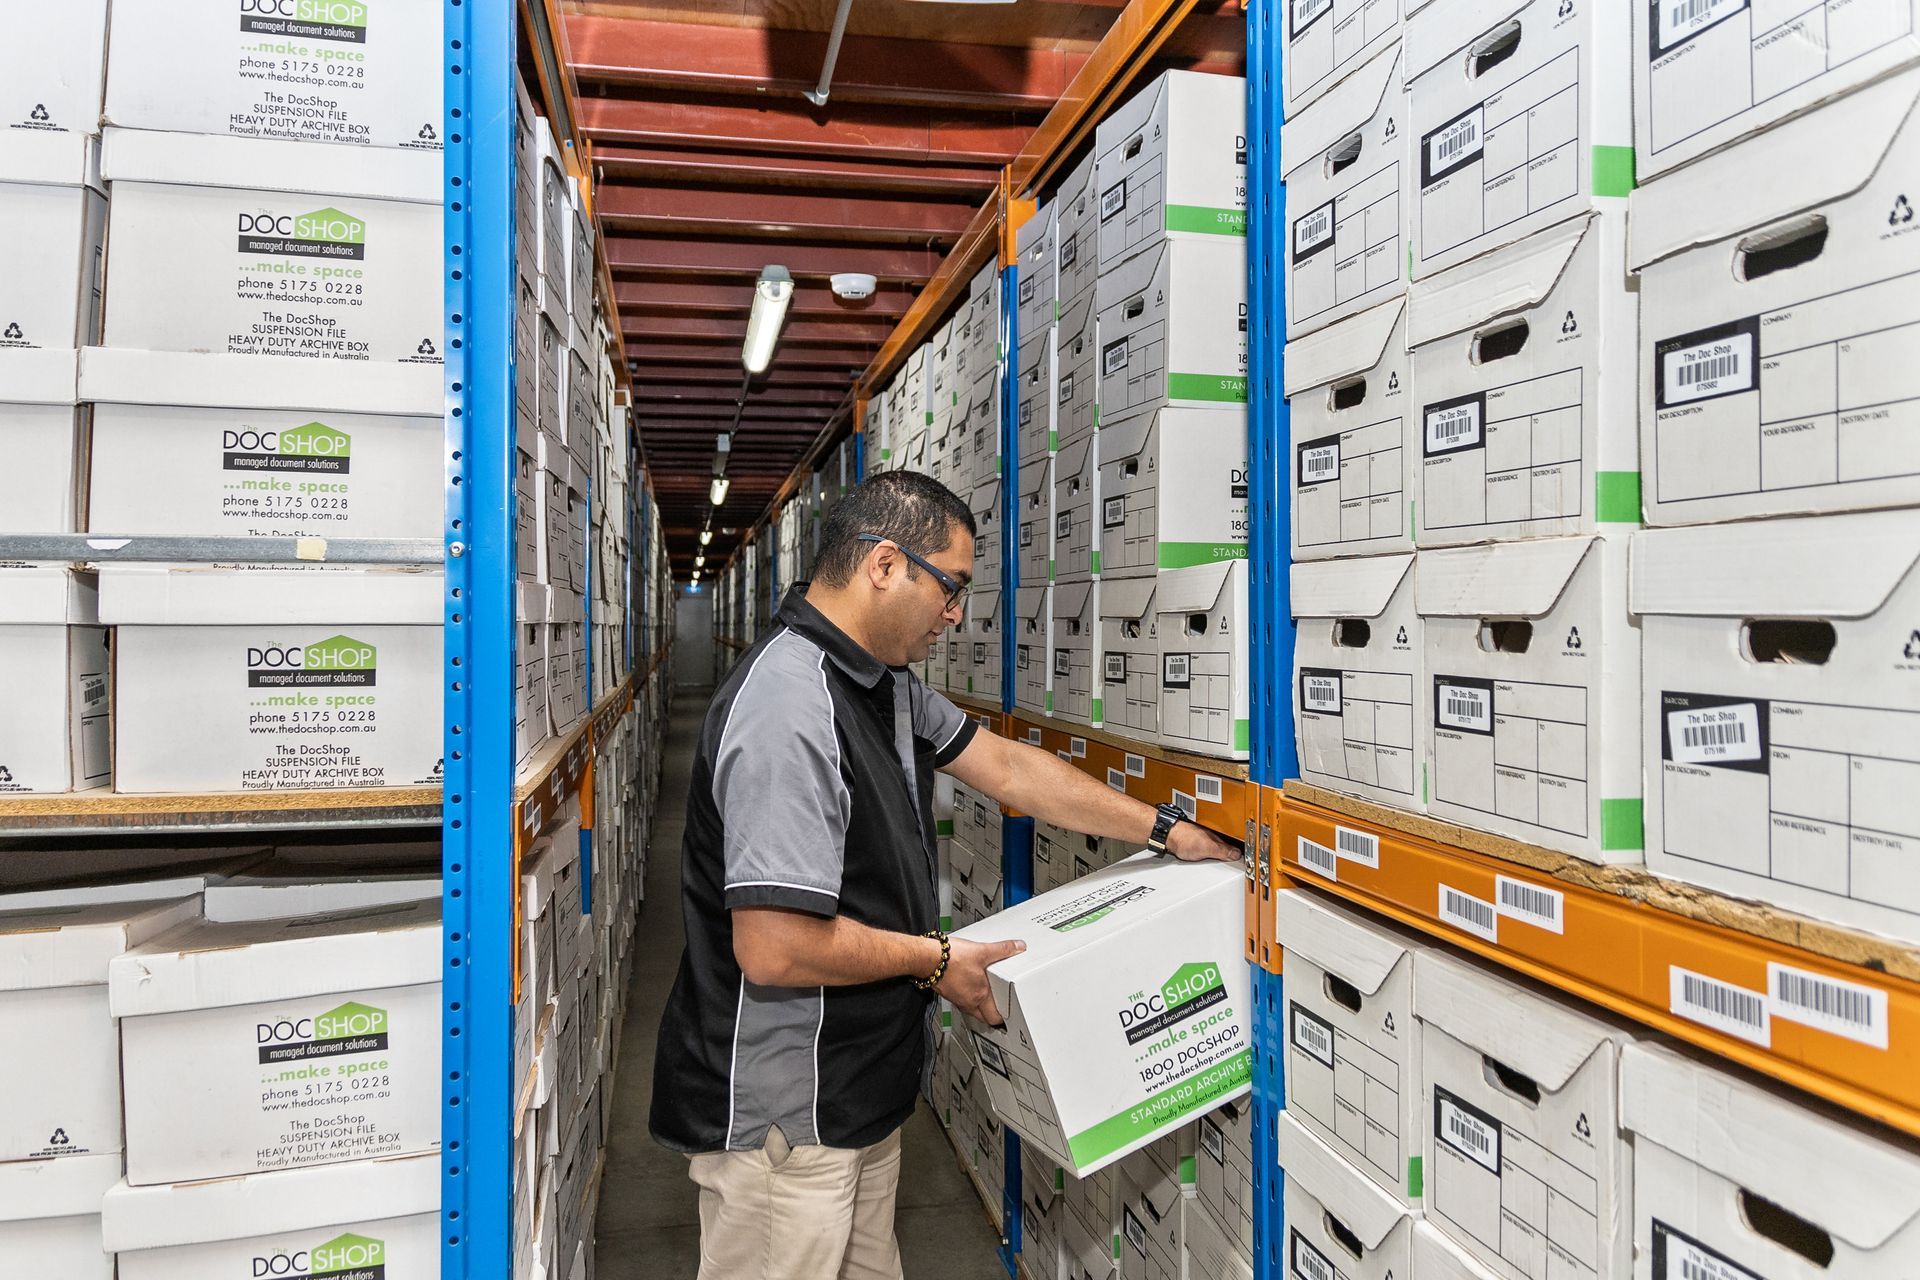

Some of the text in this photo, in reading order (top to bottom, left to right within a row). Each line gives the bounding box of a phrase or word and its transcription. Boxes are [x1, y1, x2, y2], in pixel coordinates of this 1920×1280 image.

[251, 21, 356, 39] managed document solutions
[240, 41, 365, 62] ...make space
[240, 56, 364, 78] phone 5175 0228
[239, 71, 364, 89] www.thedocshop.com.au
[264, 92, 337, 110] The DocShop
[253, 104, 347, 121] SUSPENSION FILE
[230, 114, 370, 135] HEAVY DUTY ARCHIVE BOX
[229, 124, 261, 136] Proudly
[263, 127, 320, 140] Manufactured
[333, 133, 370, 144] Australia
[249, 240, 353, 256] managed document solutions
[238, 260, 363, 280] ...make space
[238, 277, 362, 295] phone 5175 0228
[238, 292, 362, 306] www.thedocshop.com.au
[262, 312, 336, 328] The DocShop
[252, 324, 346, 338] SUSPENSION FILE
[229, 335, 369, 351] HEAVY DUTY ARCHIVE BOX
[228, 345, 259, 355] Proudly
[262, 347, 319, 358] Manufactured
[333, 349, 369, 360] Australia
[1684, 345, 1731, 362] The Doc Shop
[234, 456, 339, 469] managed document solutions
[224, 475, 348, 495] ...make space
[223, 494, 348, 509] phone 5175 0228
[222, 508, 349, 521] www.thedocshop.com.au
[1213, 548, 1248, 557] STAND
[259, 672, 365, 685] managed document solutions
[250, 692, 376, 709] ...make space
[250, 710, 375, 726] phone 5175 0228
[1688, 712, 1736, 724] The Doc Shop
[249, 723, 376, 735] www.thedocshop.com.au
[276, 744, 350, 756] The DocShop
[266, 756, 360, 767] SUSPENSION FILE
[243, 768, 384, 779] HEAVY DUTY ARCHIVE BOX
[242, 781, 275, 790] Proudly
[276, 779, 336, 789] Manufactured
[348, 777, 386, 787] Australia
[1128, 990, 1145, 1004] THE
[1130, 991, 1224, 1041] managed document solutions
[1135, 1007, 1233, 1063] ...make space
[270, 1037, 378, 1059] managed document solutions
[1139, 1024, 1239, 1082] 1800 DOCSHOP
[261, 1060, 388, 1083] ...make space
[1145, 1039, 1245, 1094] www.thedocshop.com.au
[262, 1075, 389, 1103] phone 5175 0228
[1131, 1059, 1244, 1124] STANDARD ARCHIVE
[262, 1091, 390, 1112] www.thedocshop.com.au
[1153, 1108, 1178, 1125] Proudly
[1178, 1086, 1221, 1112] Manufactured
[290, 1114, 365, 1130] The DocShop
[280, 1123, 376, 1144] SUSPENSION FILE
[257, 1133, 400, 1158] HEAVY DUTY ARCHIVE BOX
[257, 1157, 289, 1167] Proudly
[292, 1149, 350, 1163] Manufactured
[365, 1143, 401, 1154] Australia
